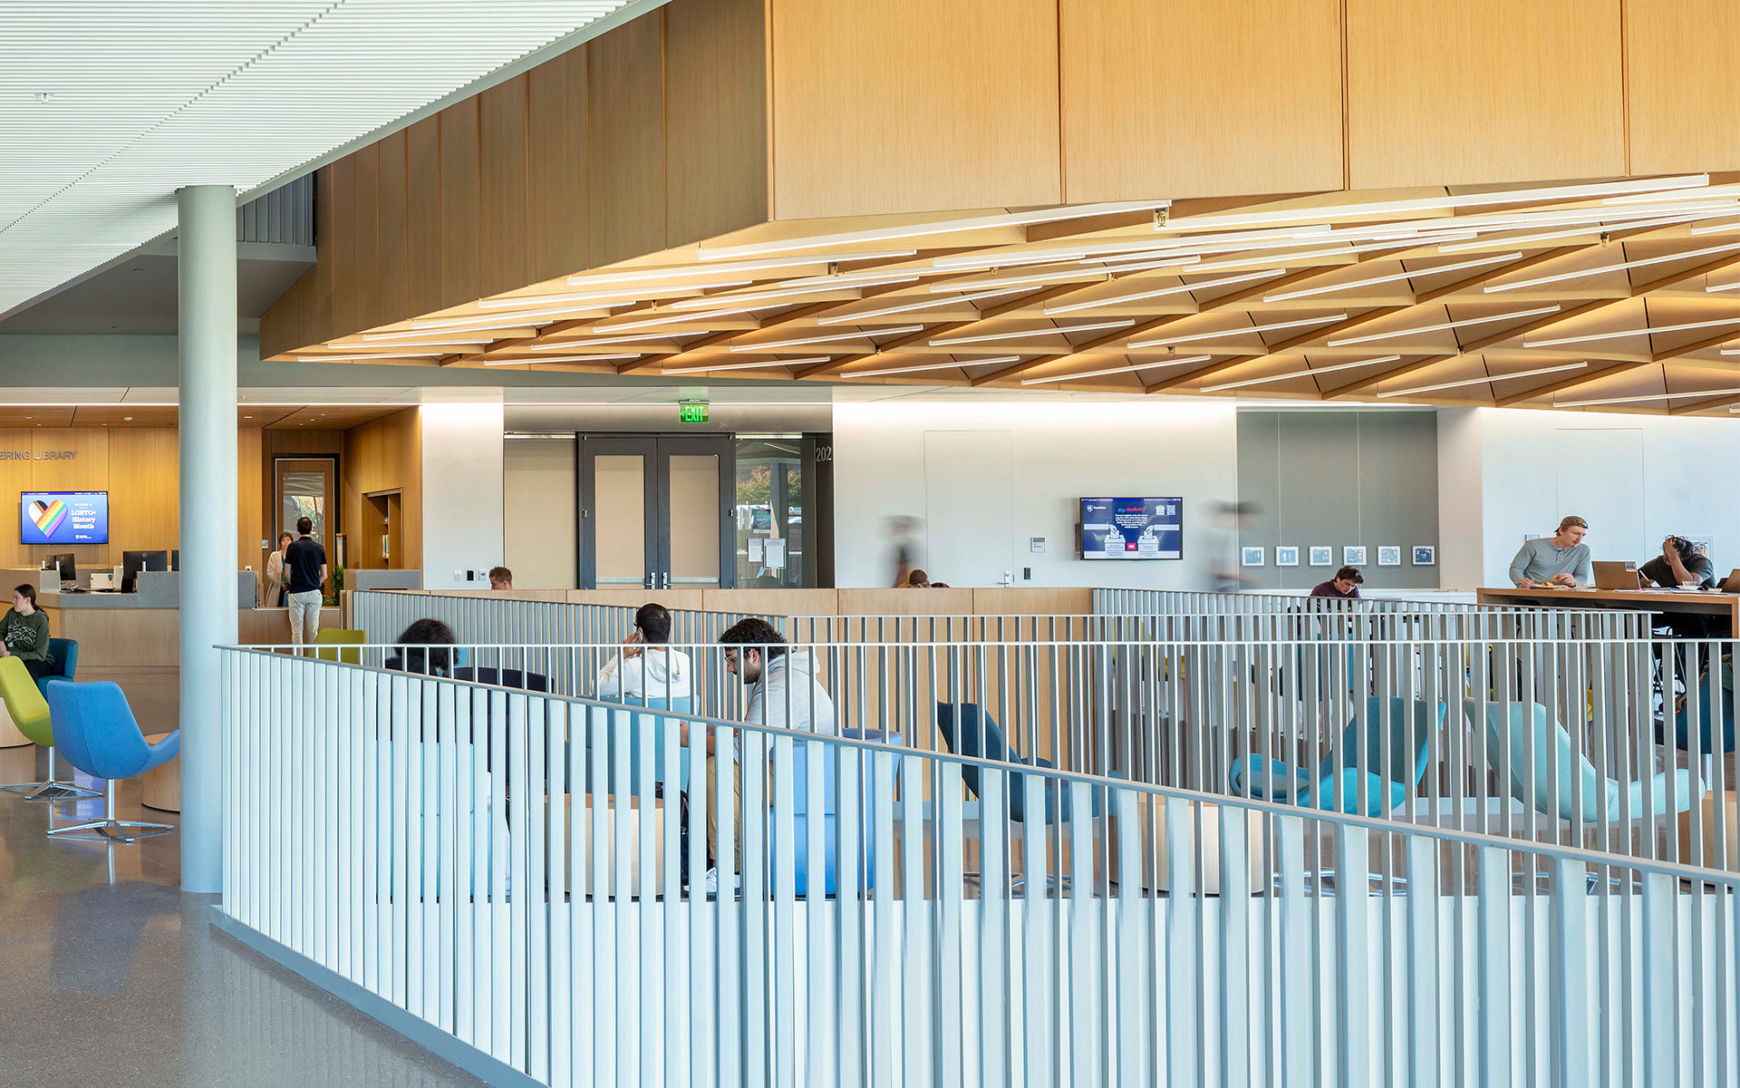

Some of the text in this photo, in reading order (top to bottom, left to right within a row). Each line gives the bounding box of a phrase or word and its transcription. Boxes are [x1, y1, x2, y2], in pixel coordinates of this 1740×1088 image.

[685, 406, 704, 422] EXIT
[33, 450, 77, 461] LIBRARY
[816, 446, 832, 462] 202
